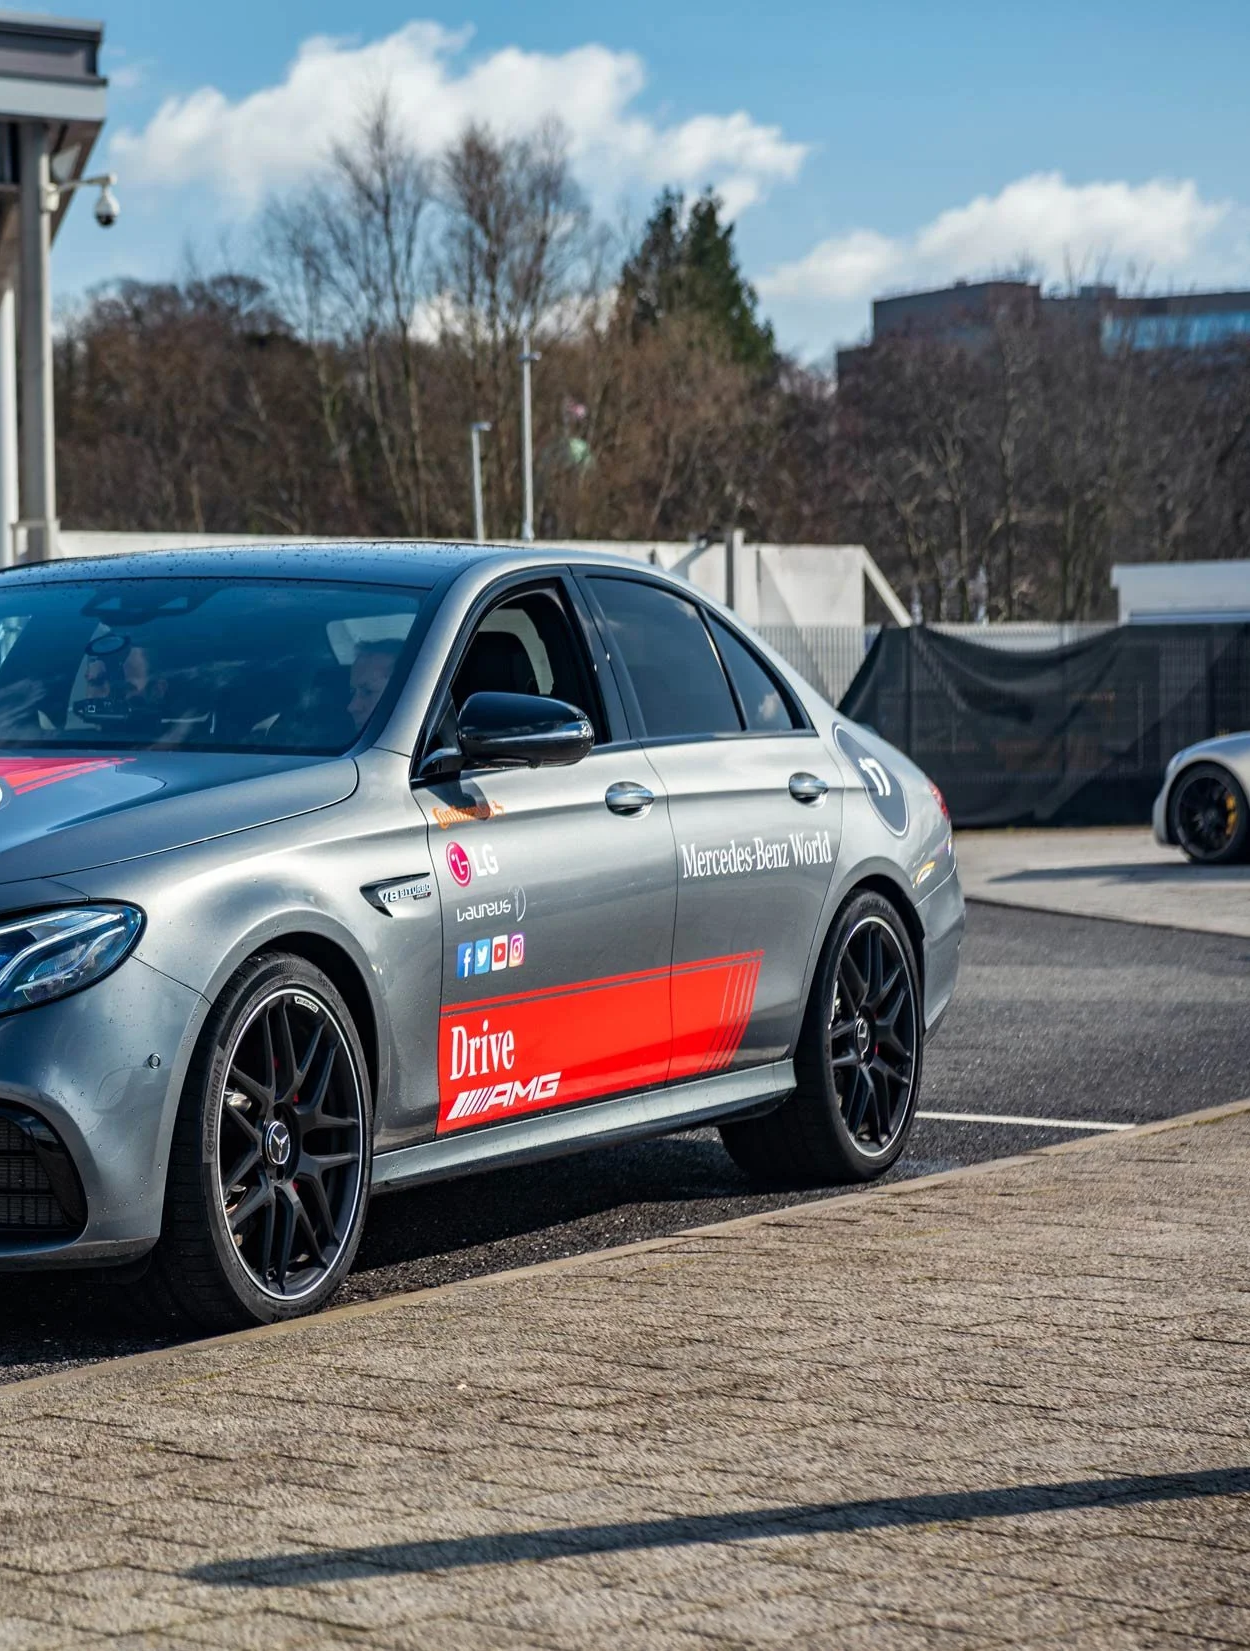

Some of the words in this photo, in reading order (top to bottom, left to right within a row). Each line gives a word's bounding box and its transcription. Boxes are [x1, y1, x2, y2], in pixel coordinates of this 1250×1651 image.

[858, 758, 891, 796] 17
[470, 843, 499, 877] LG
[680, 836, 789, 879] Mercedes-Benz
[788, 831, 833, 867] World
[378, 888, 399, 903] V8
[449, 1019, 515, 1081] Drive
